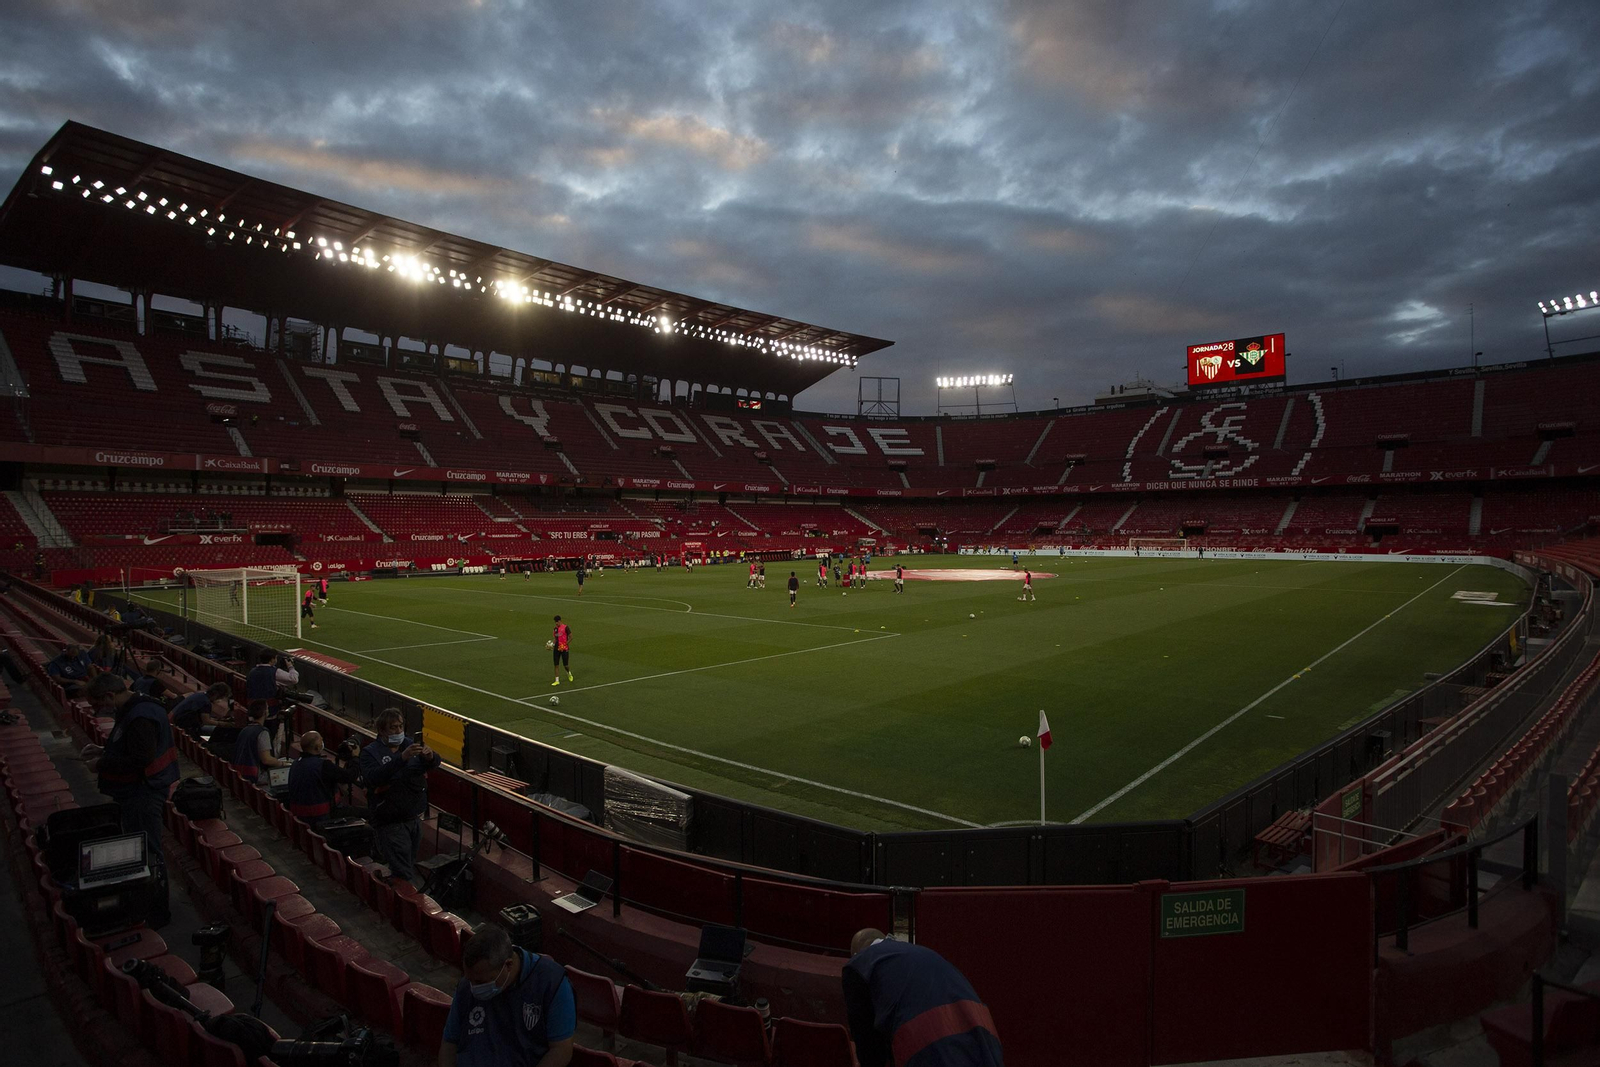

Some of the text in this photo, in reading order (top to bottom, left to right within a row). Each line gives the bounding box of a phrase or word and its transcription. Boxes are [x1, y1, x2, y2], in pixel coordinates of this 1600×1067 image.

[95, 452, 164, 466] Cruzcampo
[217, 459, 261, 470] CaixaBank
[311, 463, 360, 476] Cruzcampo
[1445, 469, 1477, 479] everfx
[1508, 469, 1547, 477] CaixaBank
[446, 470, 486, 481] Cruzcampo
[1146, 478, 1259, 490] DICEN QUE NUNCA SE RINDE
[213, 534, 243, 544] everfx
[411, 533, 444, 541] Cruzcampo
[573, 531, 587, 539] ERES
[1174, 898, 1231, 914] SALIDA DE
[1166, 912, 1239, 929] EMERGENCIA
